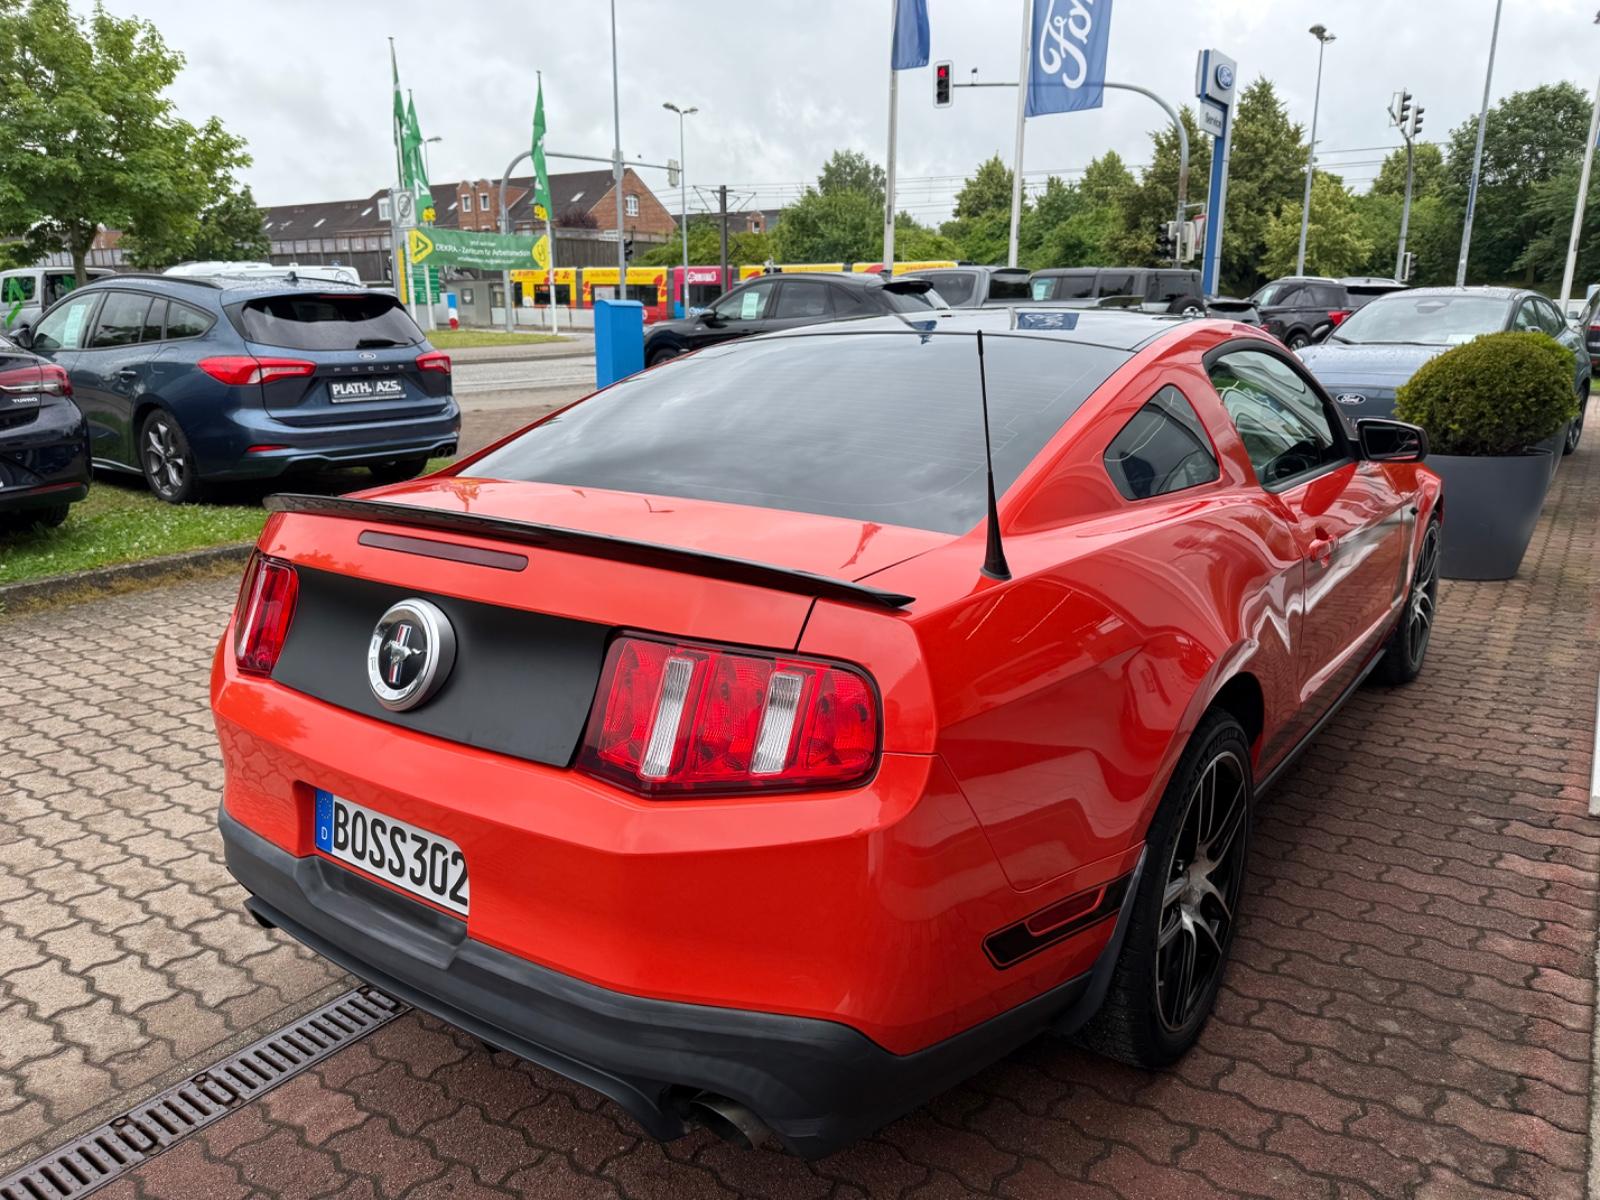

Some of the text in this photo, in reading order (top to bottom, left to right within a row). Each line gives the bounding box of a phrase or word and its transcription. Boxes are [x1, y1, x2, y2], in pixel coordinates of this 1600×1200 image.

[435, 243, 458, 252] DEKRA
[334, 364, 404, 372] FOCUS
[332, 382, 372, 395] PLATH.
[376, 380, 402, 392] AZS.
[321, 800, 468, 907] D BOSS302
